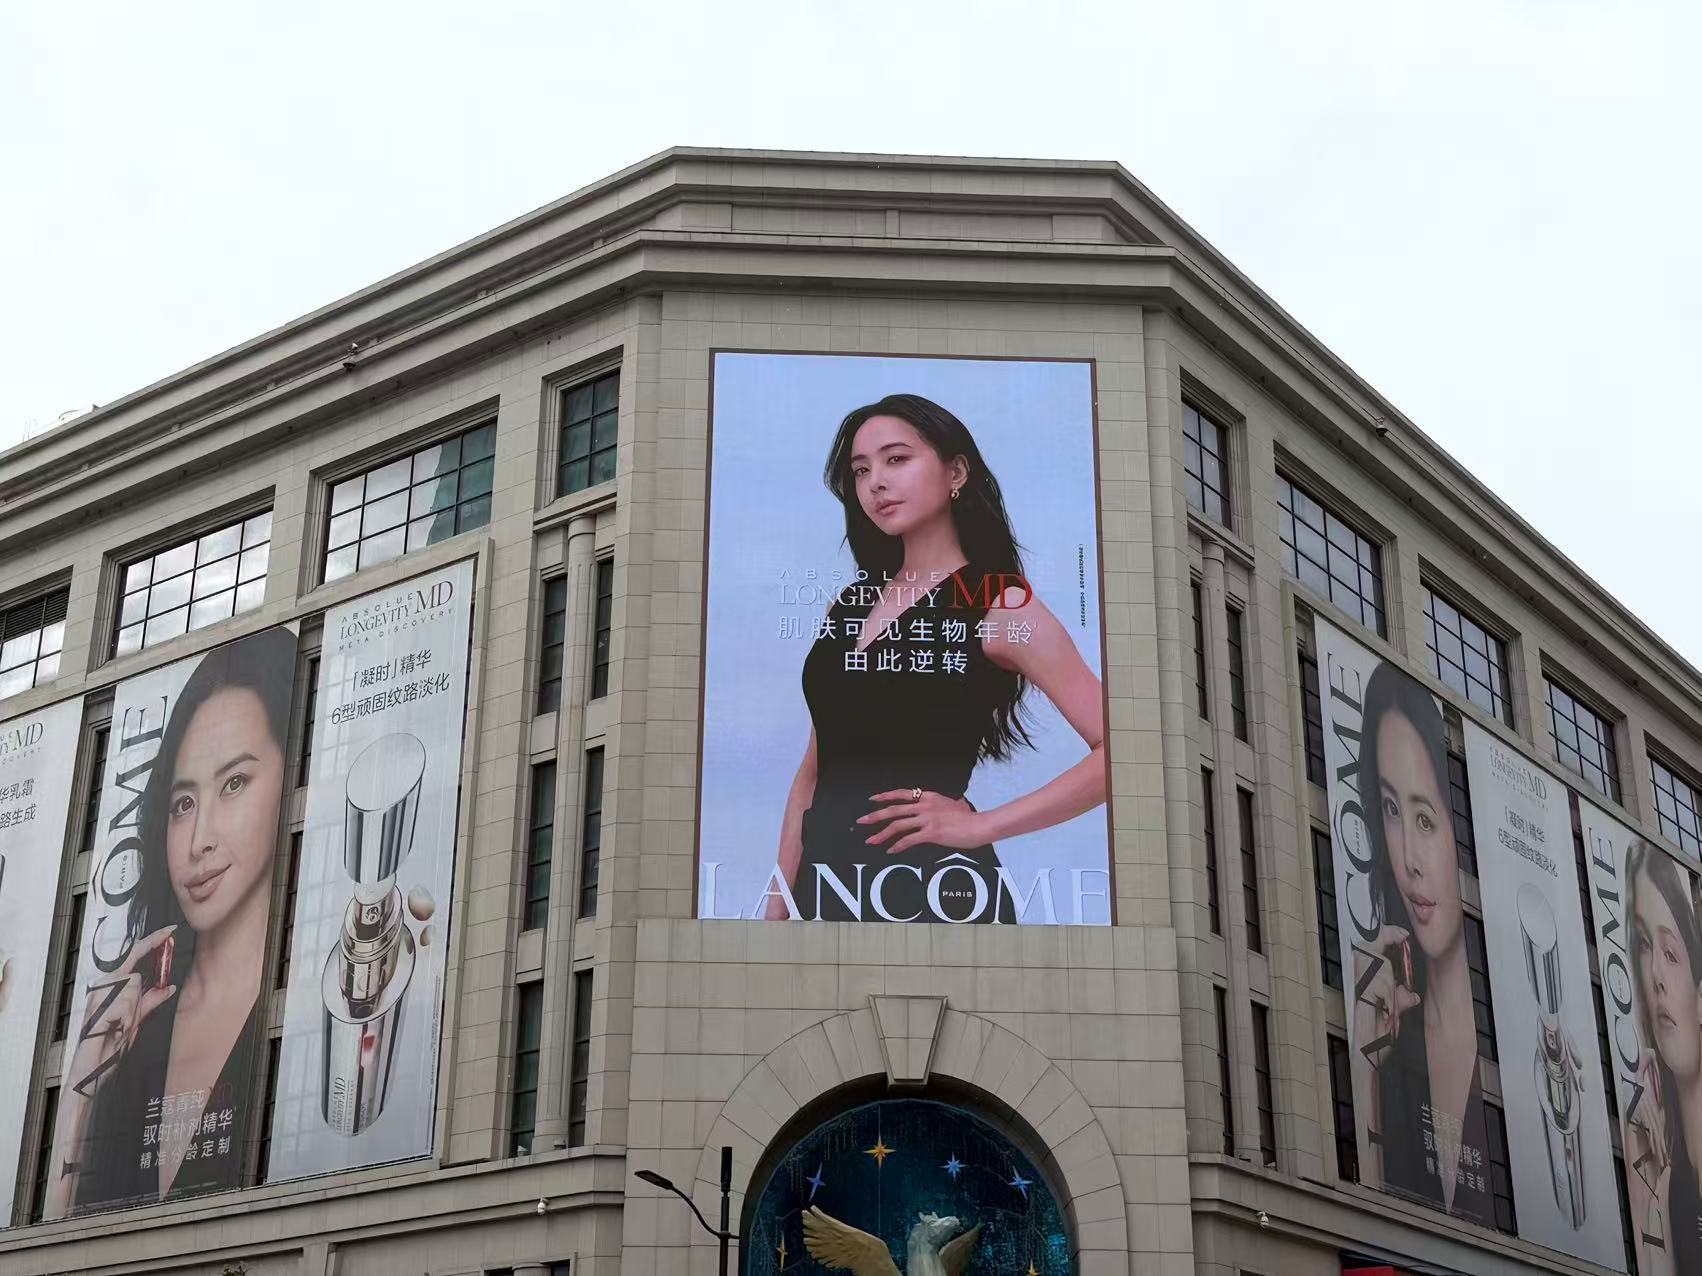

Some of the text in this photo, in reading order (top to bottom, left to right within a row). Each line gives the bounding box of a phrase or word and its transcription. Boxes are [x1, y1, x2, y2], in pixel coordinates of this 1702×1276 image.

[777, 572, 1033, 610] LONGEVITY MD
[779, 569, 945, 583] ABSOLUE
[340, 580, 454, 640] LONGEVITY MD
[341, 592, 413, 624] ABSOLUE
[777, 615, 1034, 645] 肌肤可见生物年龄
[844, 648, 968, 675] 由此逆转
[331, 672, 450, 725] 6型顽固纹路淡化
[699, 852, 1111, 927] LANCÔME
[942, 890, 974, 898] PARIS
